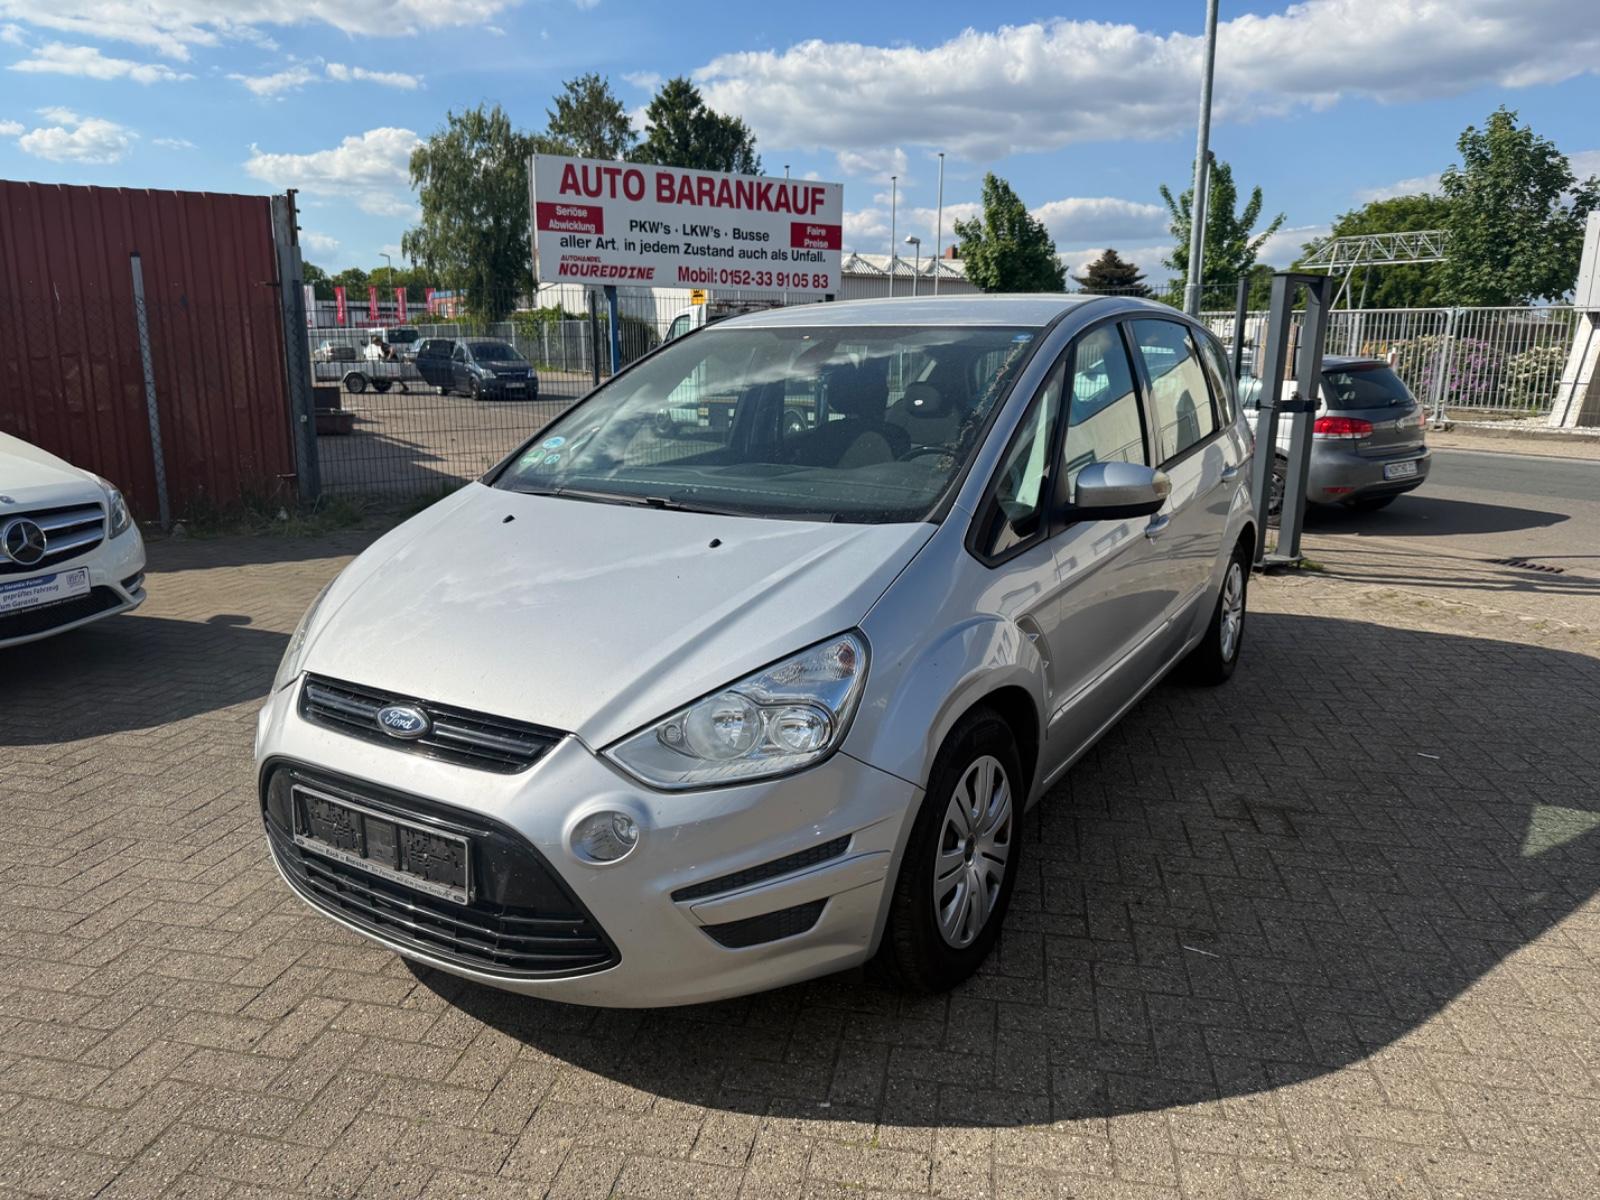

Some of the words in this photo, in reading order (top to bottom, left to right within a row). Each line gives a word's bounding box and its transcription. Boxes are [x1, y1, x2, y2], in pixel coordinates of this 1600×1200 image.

[559, 163, 645, 202] AUTO
[656, 171, 826, 216] BARANKAUF
[556, 206, 588, 217] Seriöse
[549, 218, 596, 234] Abwicklung
[630, 219, 671, 235] PKW's
[682, 223, 721, 239] LKW's
[733, 228, 770, 242] Busse
[806, 226, 827, 237] Faire
[560, 235, 592, 249] aller
[624, 238, 636, 252] in
[639, 240, 680, 255] jedem
[683, 243, 734, 258] Zustand
[738, 247, 768, 260] auch
[770, 250, 788, 261] als
[791, 250, 826, 263] Unfall.
[804, 239, 829, 249] Preise
[560, 254, 602, 263] AUTOHANDEL
[558, 262, 656, 281] NOUREDDINE
[678, 266, 718, 284] Mobil:
[719, 268, 773, 286] 0152-33
[812, 274, 829, 289] 83
[385, 710, 415, 729] Ford
